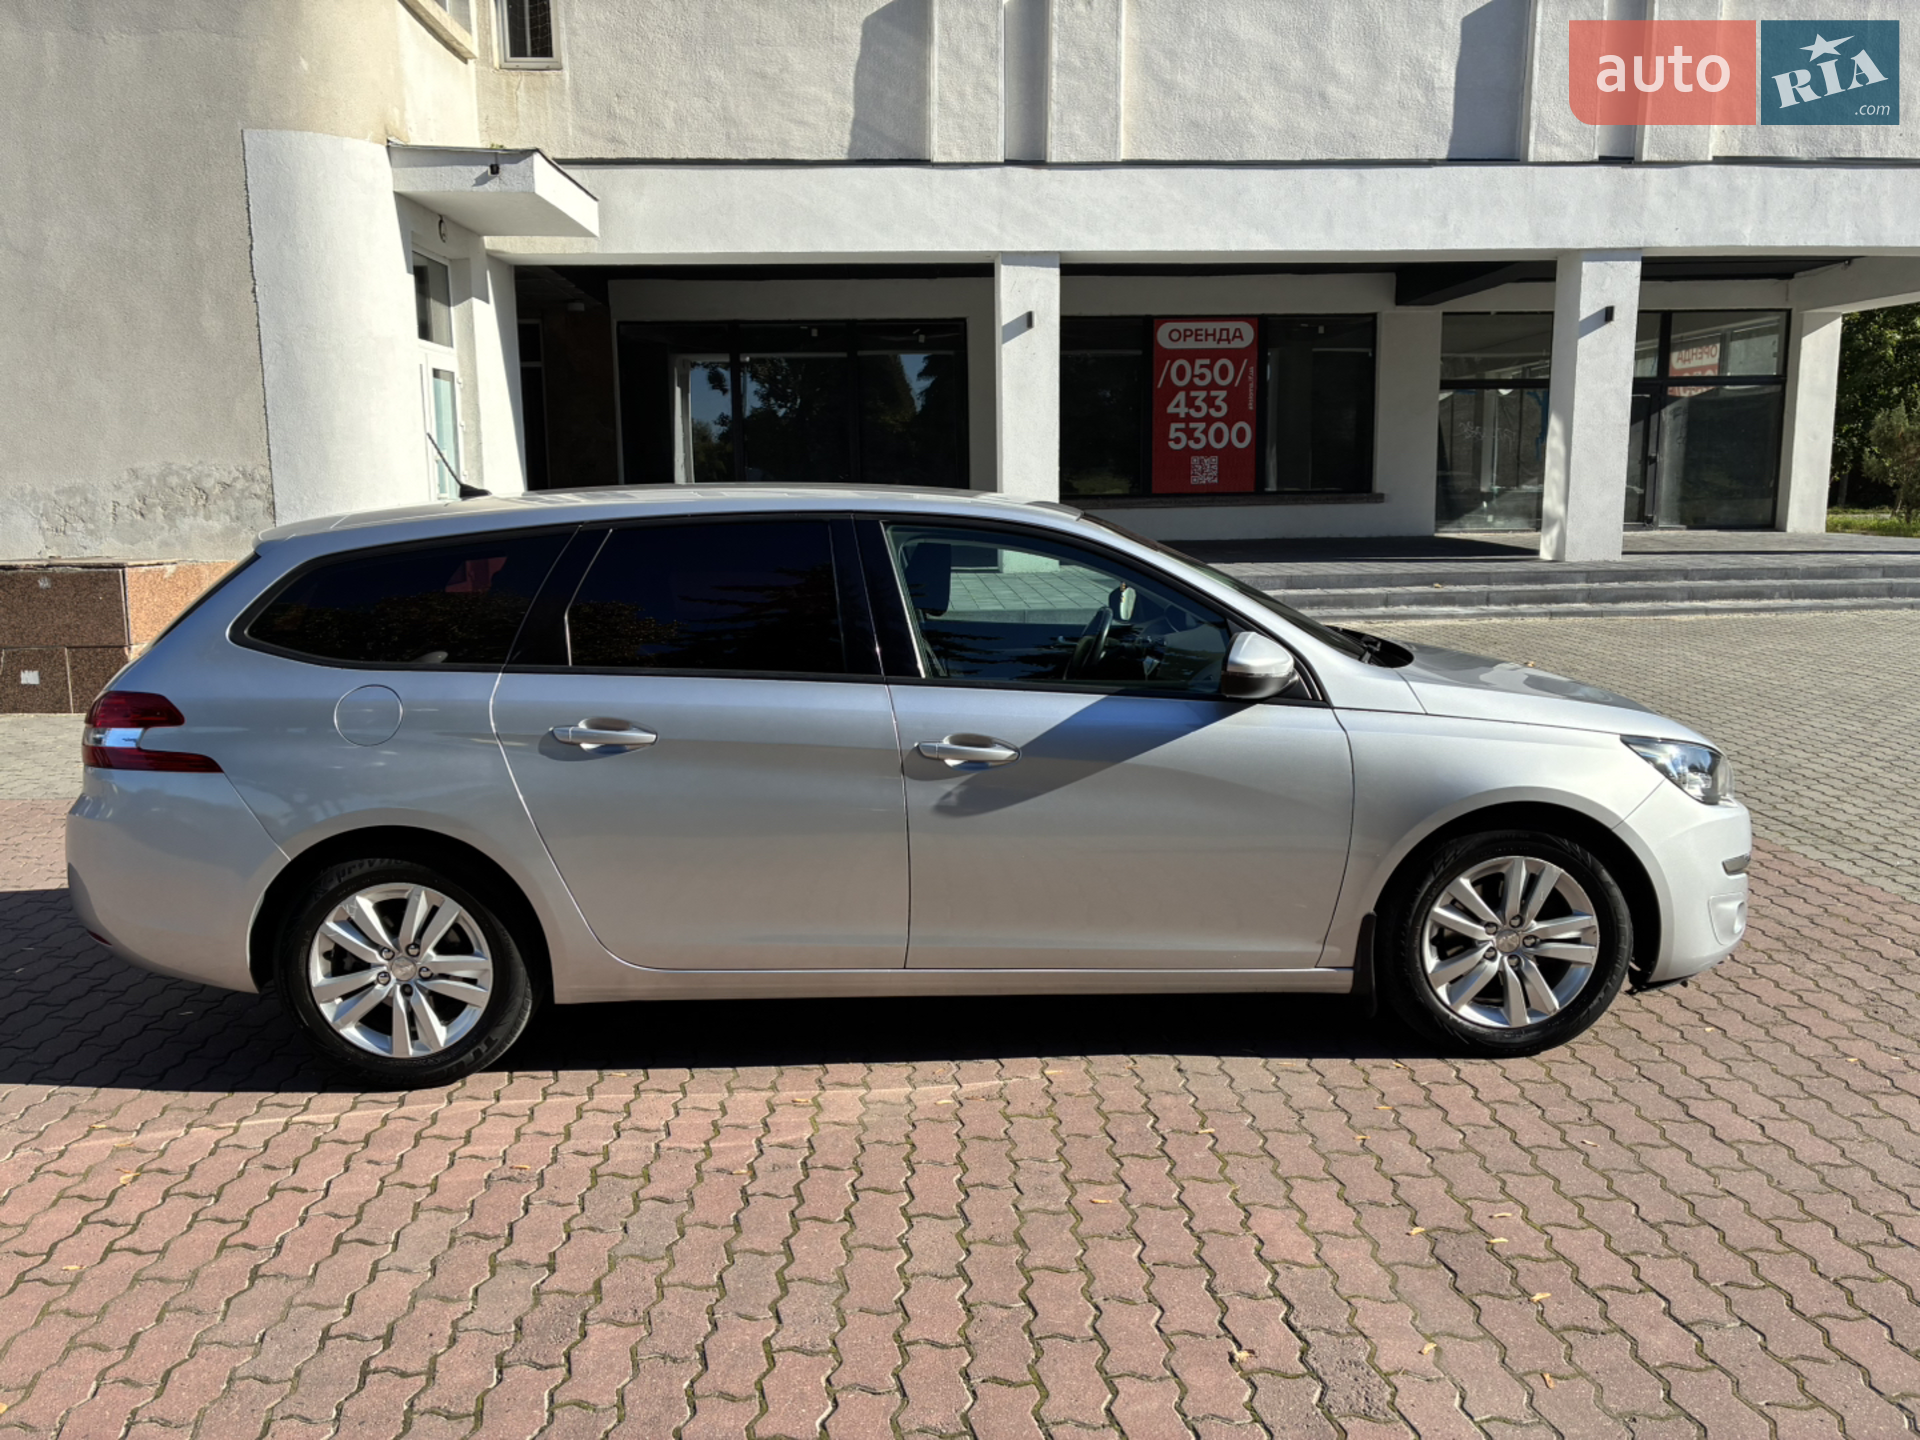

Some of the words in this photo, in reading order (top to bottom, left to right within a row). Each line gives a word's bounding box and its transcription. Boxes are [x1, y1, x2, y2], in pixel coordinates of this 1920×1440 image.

[1168, 327, 1244, 344] ОРЕНДА
[1157, 358, 1248, 388] /050/
[1166, 390, 1228, 418] 433
[1167, 421, 1252, 450] 5300
